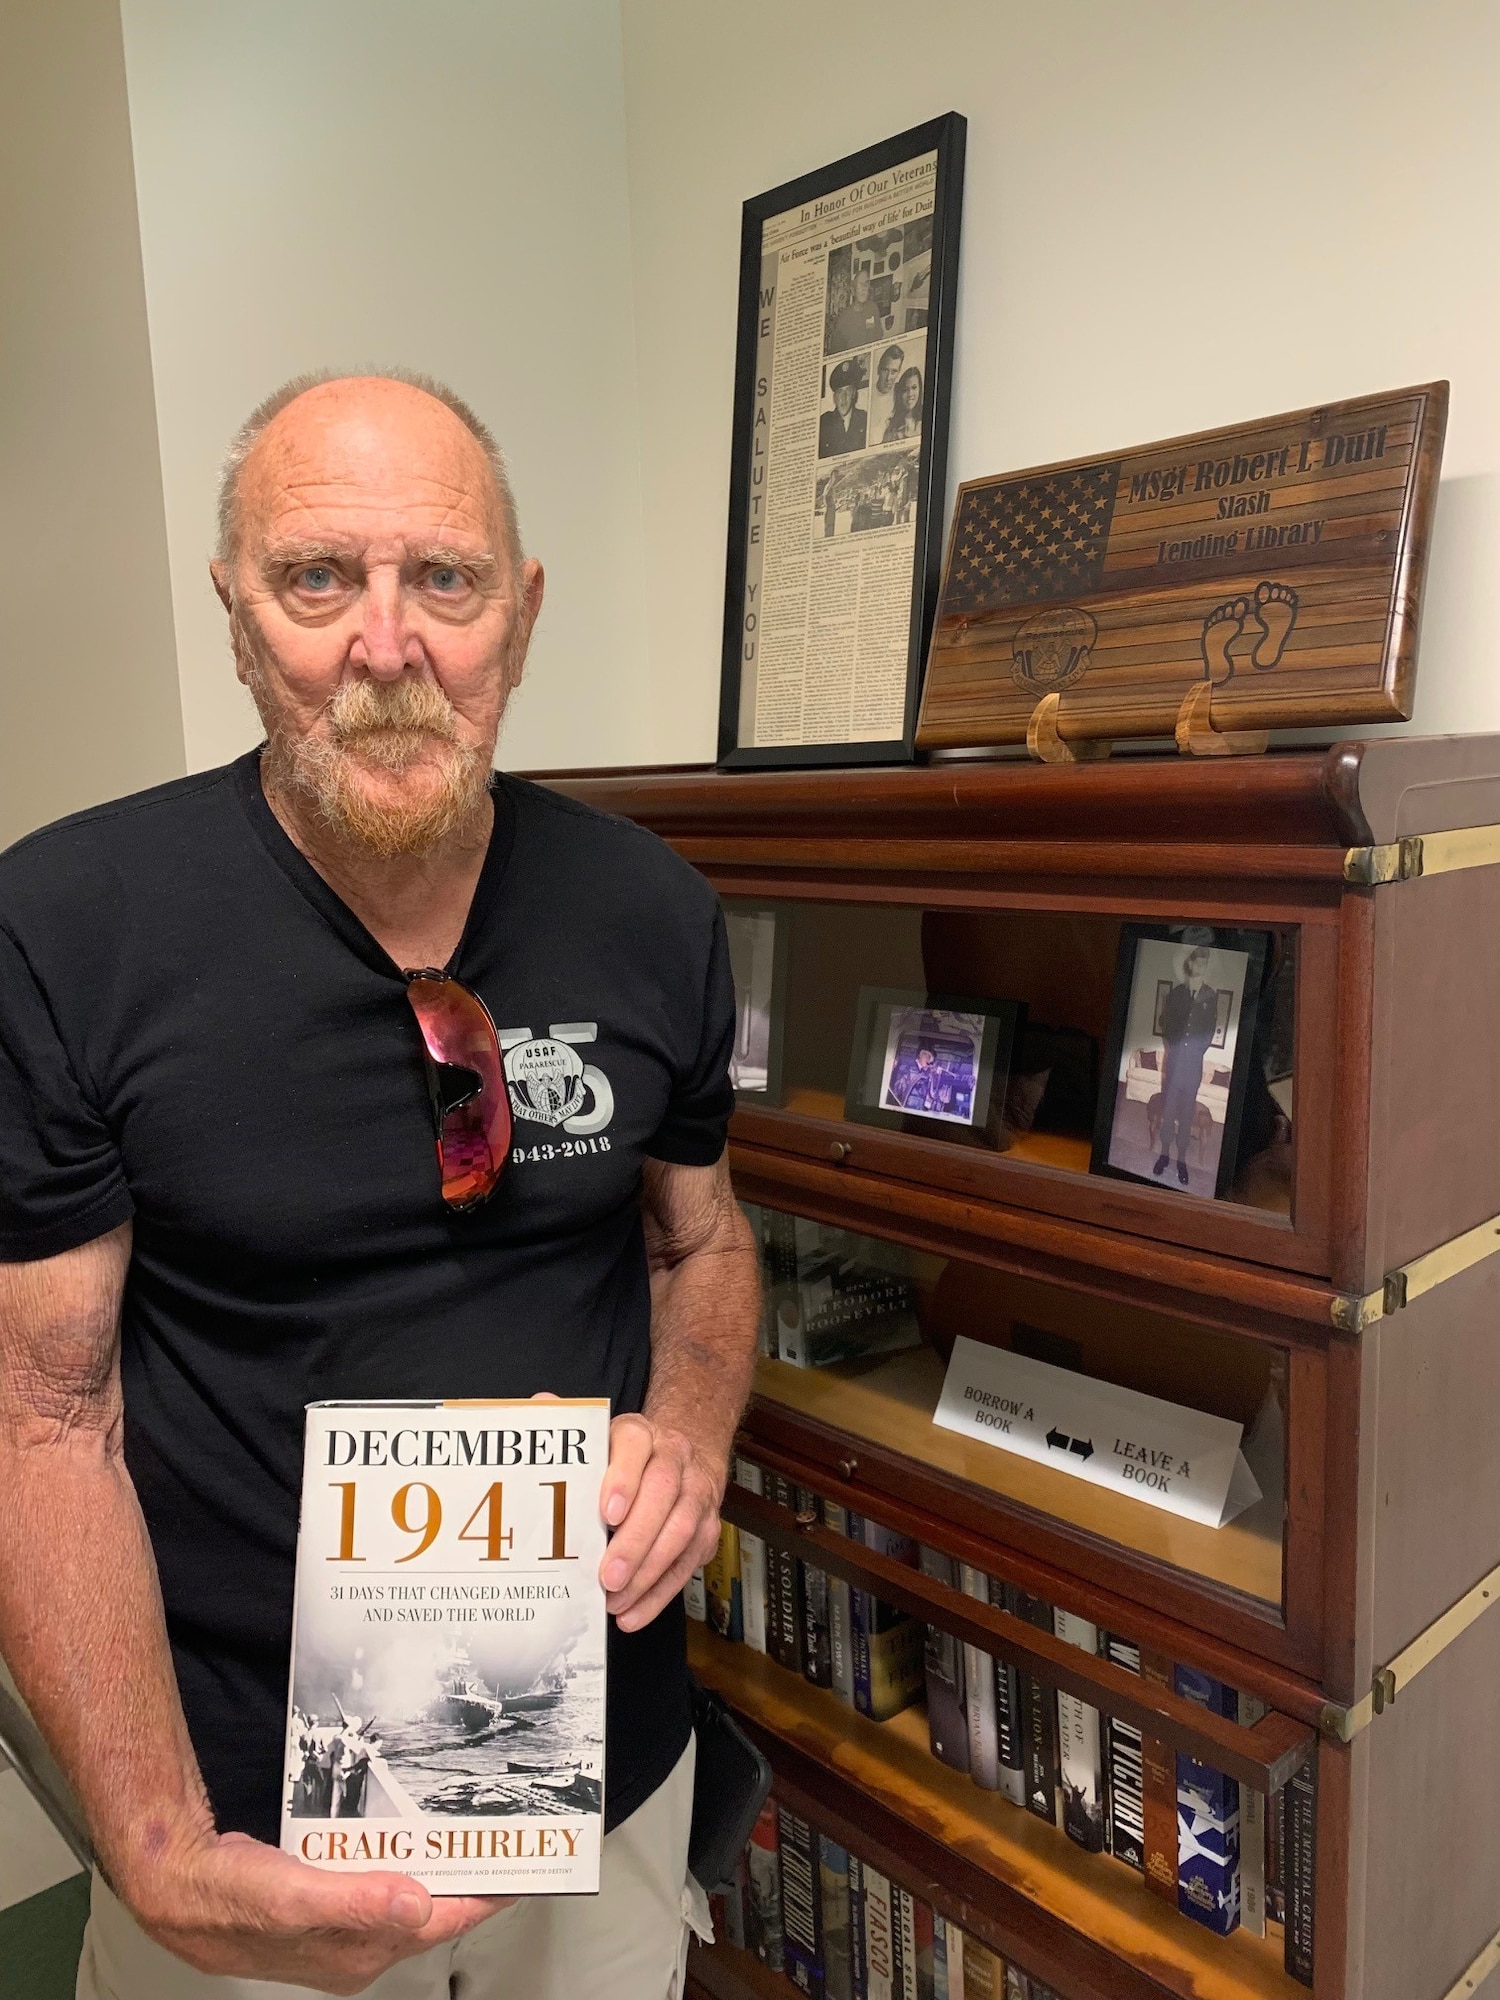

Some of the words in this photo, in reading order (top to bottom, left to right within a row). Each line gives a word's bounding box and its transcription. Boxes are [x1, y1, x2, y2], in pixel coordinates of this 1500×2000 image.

[800, 209, 811, 223] In
[815, 197, 846, 218] Honor
[850, 185, 865, 203] Of
[867, 179, 888, 196] Our
[892, 160, 937, 185] Veterans
[780, 251, 791, 265] Air
[791, 247, 808, 261] Force
[810, 243, 822, 253] was
[862, 221, 877, 234] way
[878, 215, 888, 228] of
[902, 206, 913, 219] for
[759, 287, 776, 338] WE
[1128, 462, 1187, 504] MSgt
[1193, 445, 1290, 495] Robert
[1296, 441, 1315, 474] L
[1216, 489, 1271, 521] Slash
[1157, 529, 1239, 565] Lending
[1245, 518, 1326, 552] Library
[744, 584, 758, 661] YOU
[519, 1058, 566, 1070] PARARESCUE
[525, 1046, 556, 1058] USAF
[512, 1099, 527, 1117] THAT
[528, 1110, 558, 1124] OTHERS
[558, 1107, 573, 1119] MAY
[573, 1093, 583, 1111] LIVE
[512, 1136, 612, 1164] 943-2018
[804, 1284, 908, 1318] THEODORE
[806, 1301, 908, 1332] ROOSEVELT
[964, 1386, 1022, 1420] BORROW
[1023, 1406, 1034, 1421] A
[975, 1411, 1012, 1434] BOOK
[323, 1428, 590, 1467] DECEMBER
[1113, 1439, 1174, 1472] LEAVE
[1177, 1461, 1191, 1478] A
[1122, 1464, 1171, 1493] BOOK
[326, 1480, 579, 1564] 1941
[330, 1586, 345, 1601] 31
[349, 1586, 384, 1601] DAYS
[388, 1586, 427, 1600] THAT
[430, 1585, 500, 1600] CHANGED
[503, 1585, 570, 1600] AMERICA
[780, 1565, 794, 1644] SOLDIER
[363, 1608, 394, 1622] AND
[397, 1608, 444, 1622] SAVED
[446, 1608, 478, 1622] THE
[480, 1607, 535, 1621] WORLD
[833, 1604, 842, 1641] MARK
[807, 1633, 817, 1654] Task
[834, 1641, 843, 1678] OWEN
[974, 1704, 982, 1736] BRYAN
[1031, 1710, 1043, 1745] LION
[1061, 1705, 1071, 1761] LEADER
[1075, 1722, 1084, 1745] OF
[1112, 1741, 1145, 1845] VICTORY
[1302, 1799, 1313, 1826] THE
[301, 1830, 415, 1861] CRAIG
[425, 1828, 584, 1859] SHIRLEY
[405, 1869, 434, 1877] REAGAN'S
[435, 1869, 473, 1877] REVOLUTION
[475, 1868, 490, 1876] AND
[491, 1868, 530, 1877] RENDEZVOUS
[548, 1867, 573, 1875] DESTINY
[1302, 1834, 1313, 1898] IMPERIAL
[868, 1891, 890, 1979] FIASCO
[902, 1893, 912, 1953] ODIGAL
[1301, 1904, 1313, 1955] CRUISE
